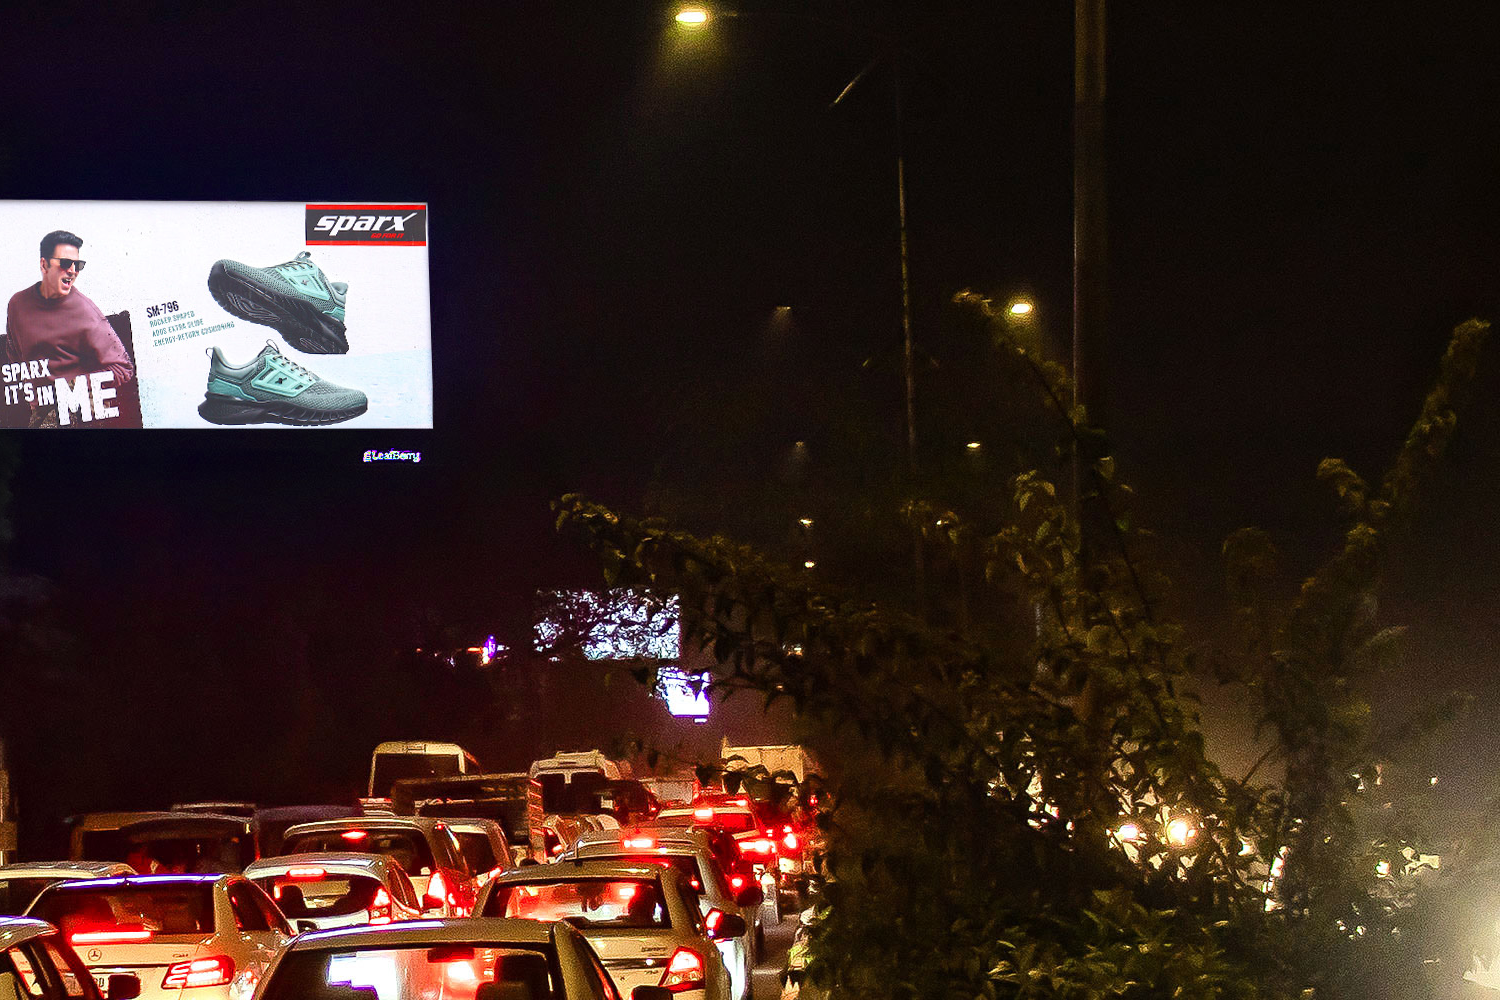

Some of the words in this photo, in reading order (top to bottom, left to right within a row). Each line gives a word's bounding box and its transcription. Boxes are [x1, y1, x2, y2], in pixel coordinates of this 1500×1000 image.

[313, 212, 418, 237] sparx
[146, 300, 180, 319] SM-796
[168, 323, 187, 334] EXTRA
[1, 358, 52, 383] SPARX
[4, 382, 35, 406] IT'S
[36, 385, 55, 407] IN
[54, 370, 120, 426] ME
